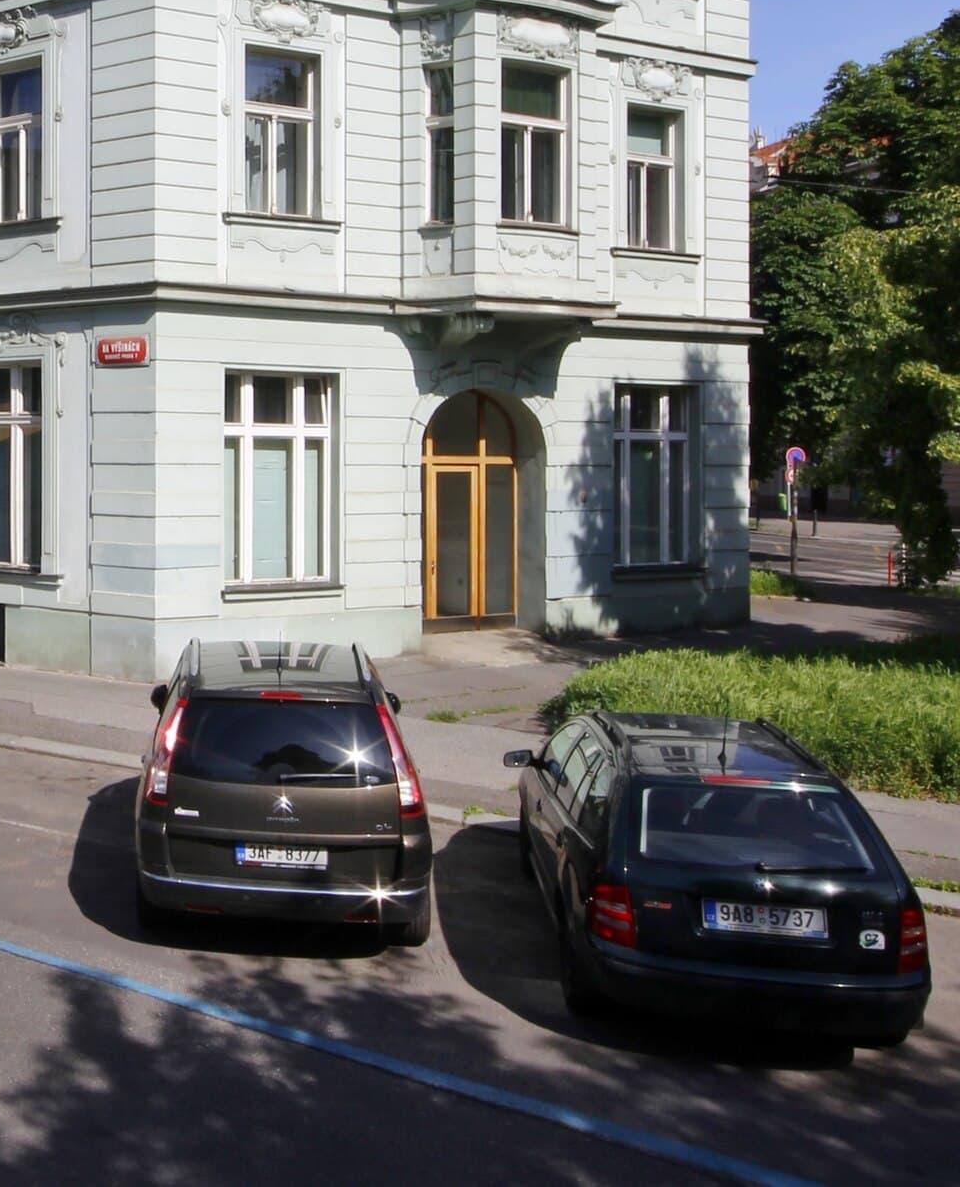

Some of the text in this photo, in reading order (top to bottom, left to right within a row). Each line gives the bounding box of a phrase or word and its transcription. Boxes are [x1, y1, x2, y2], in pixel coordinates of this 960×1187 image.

[247, 844, 321, 862] 3AF 8377
[720, 904, 815, 928] 9A8 5737
